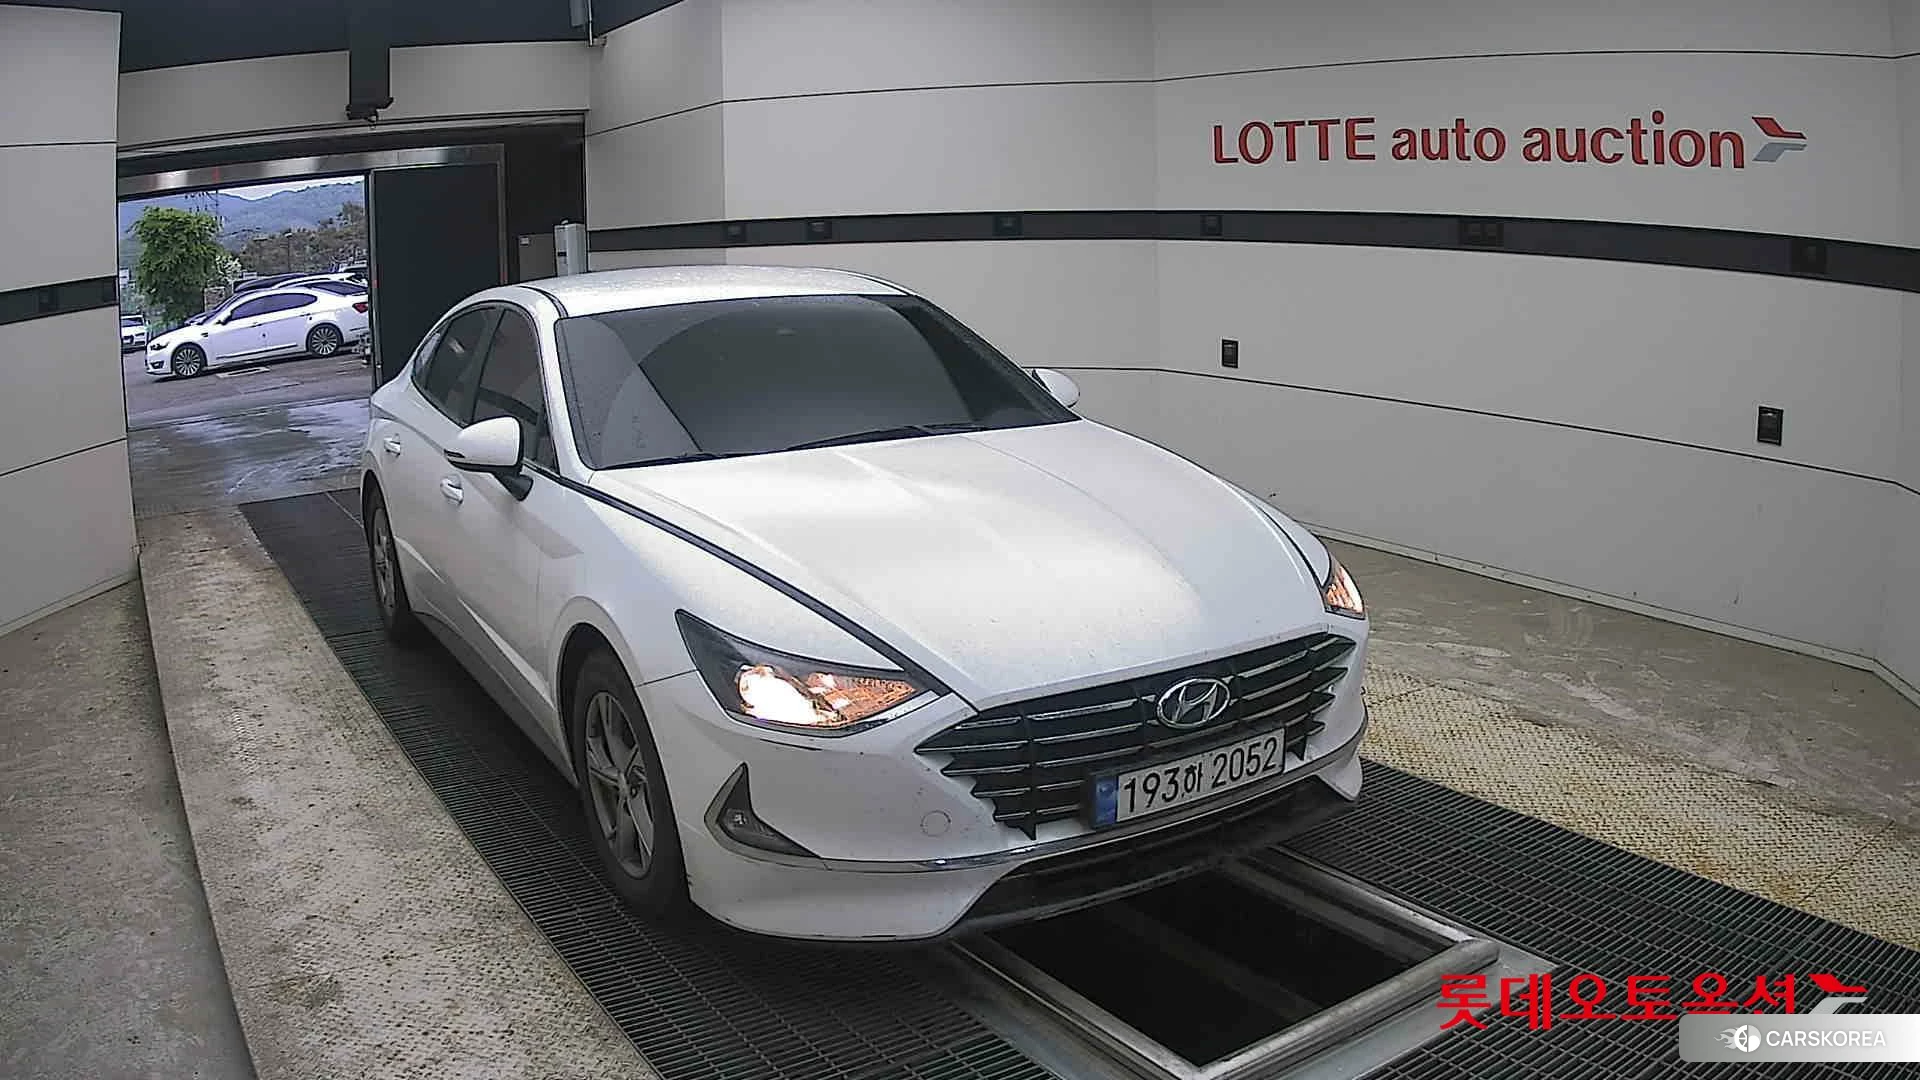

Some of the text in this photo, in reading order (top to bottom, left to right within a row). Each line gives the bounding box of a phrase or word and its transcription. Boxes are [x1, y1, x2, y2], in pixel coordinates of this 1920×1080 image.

[1213, 111, 1746, 168] LOTTE auto auction
[1211, 737, 1278, 790] 2052
